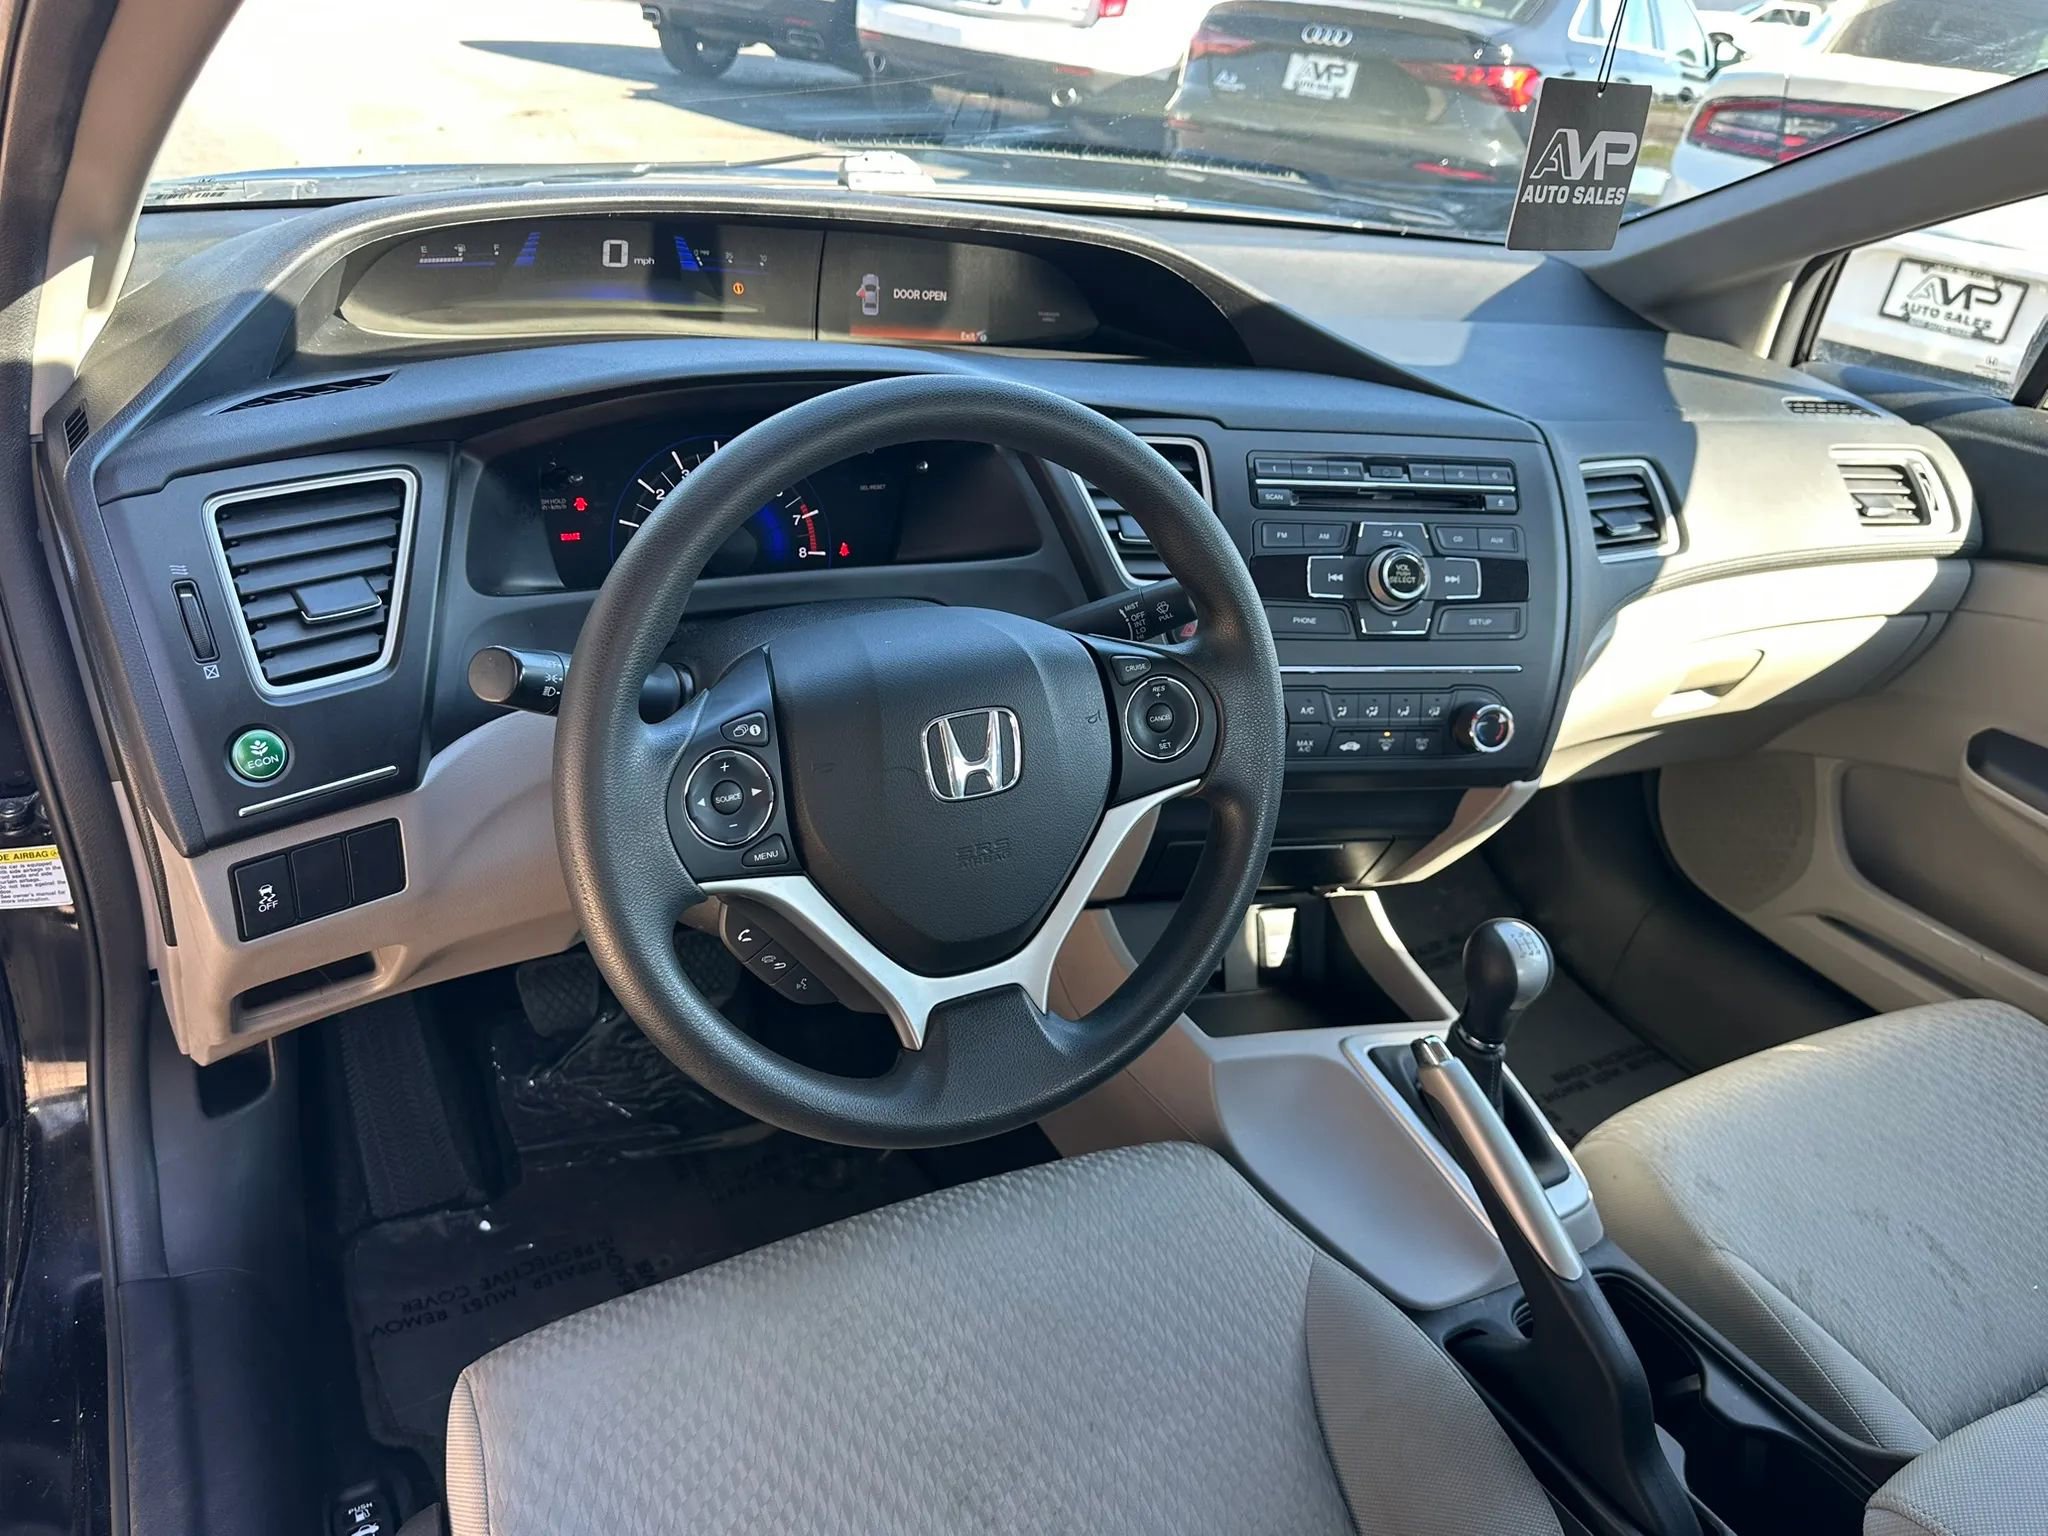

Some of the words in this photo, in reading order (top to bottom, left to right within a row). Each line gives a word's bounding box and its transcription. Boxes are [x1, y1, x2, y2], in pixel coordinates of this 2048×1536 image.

[1529, 128, 1638, 181] AVP
[1520, 184, 1571, 204] AUTO
[1572, 186, 1626, 206] SALES
[602, 239, 629, 268] 0
[633, 256, 655, 267] mph
[893, 288, 921, 300] DOOR
[921, 290, 948, 302] OPEN
[1906, 272, 2002, 310] AVP
[1900, 301, 1940, 319] AUTO
[1943, 311, 1993, 331] SALES
[655, 488, 665, 499] 2
[1264, 493, 1284, 501] SCAN
[792, 514, 801, 526] 7
[1276, 531, 1288, 539] FM
[1318, 532, 1331, 540] AM
[1452, 535, 1464, 543] CD
[798, 547, 808, 559] 8
[1124, 601, 1140, 613] MIST
[1130, 611, 1146, 622] OFF
[1158, 613, 1174, 622] PULL
[1292, 616, 1318, 625] PHONE
[1133, 619, 1147, 628] INT
[1468, 618, 1493, 627] SETUP
[1135, 627, 1147, 636] LO
[1124, 663, 1148, 672] CRUISE
[1299, 706, 1315, 715] A/C
[1158, 742, 1172, 750] SET
[247, 754, 280, 770] ECON
[715, 791, 742, 805] SOURCE
[13, 850, 49, 860] AIRBAG
[753, 850, 779, 862] MENU
[258, 900, 279, 913] OFF
[347, 1502, 373, 1515] PUSH
